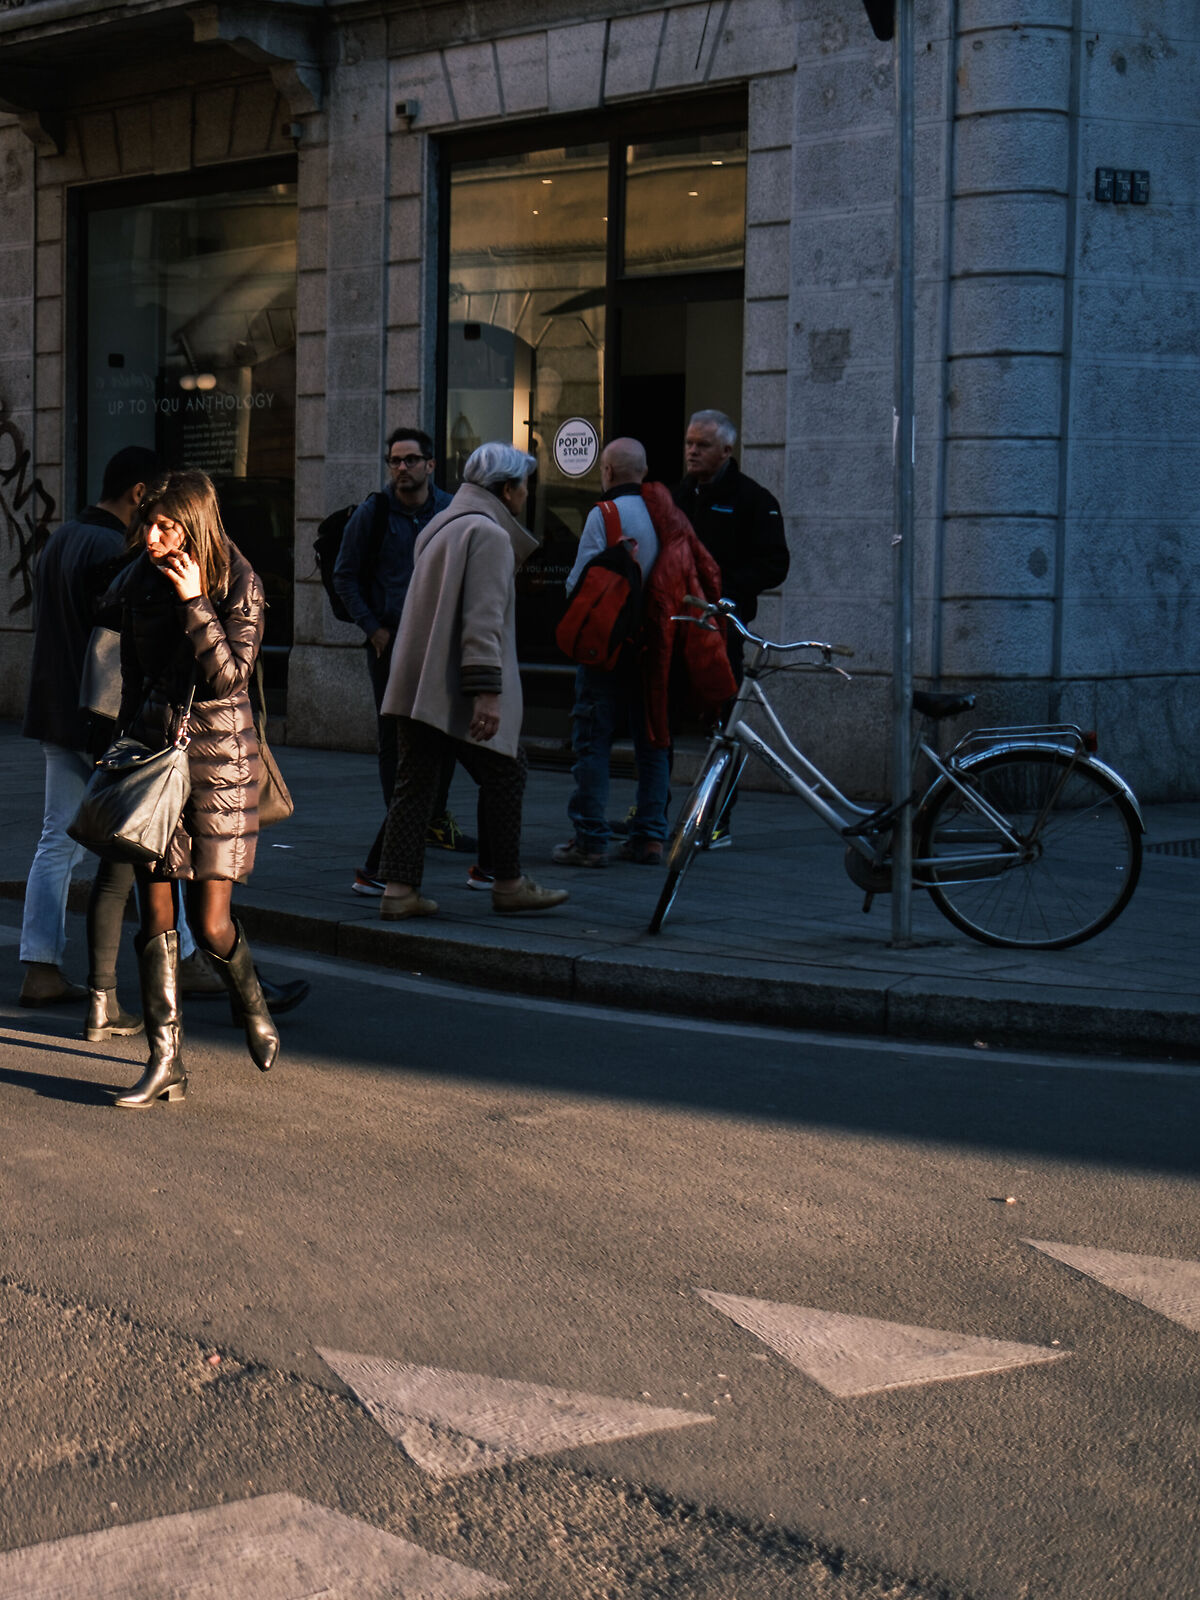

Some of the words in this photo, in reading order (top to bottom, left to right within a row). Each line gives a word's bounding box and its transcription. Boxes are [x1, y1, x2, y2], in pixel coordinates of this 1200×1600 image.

[108, 401, 124, 415] UP
[129, 399, 147, 414] TO
[152, 397, 180, 413] YOU
[185, 392, 275, 412] ANTHOLOGY
[558, 437, 578, 448] POP
[580, 436, 594, 447] UP
[563, 447, 589, 456] STORE
